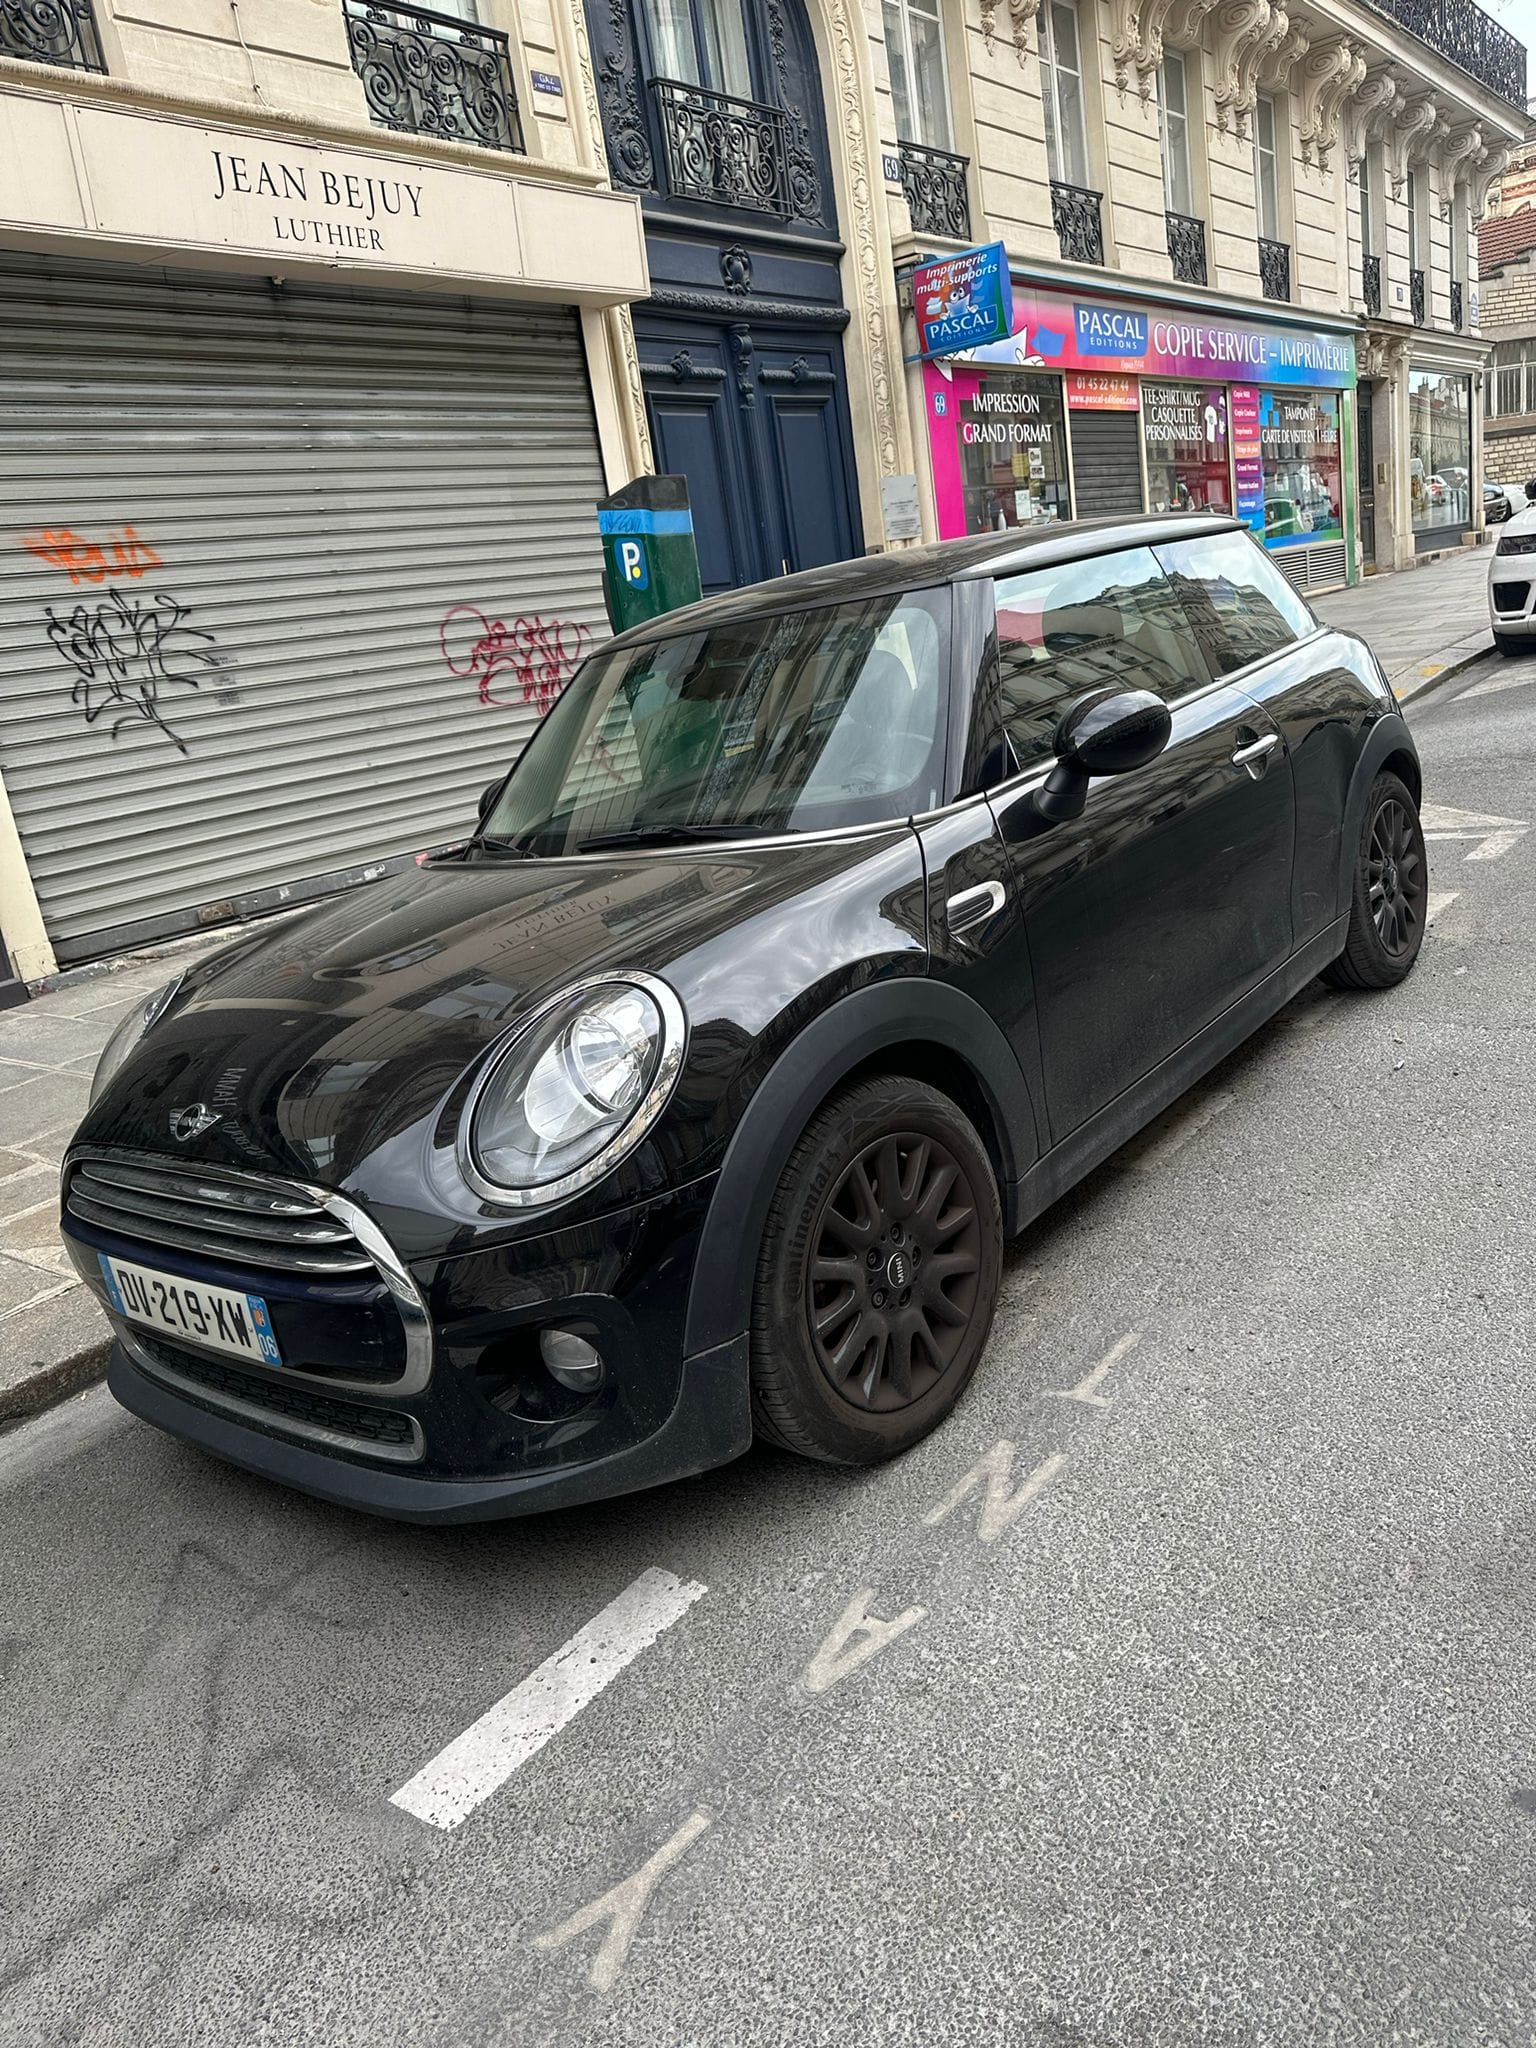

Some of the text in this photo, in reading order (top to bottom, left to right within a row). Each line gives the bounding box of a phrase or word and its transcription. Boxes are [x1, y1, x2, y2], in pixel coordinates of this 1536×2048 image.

[884, 157, 899, 180] 69
[210, 150, 423, 221] JEAN BEJUY
[272, 215, 385, 251] LUTHIER
[926, 253, 987, 279] Imprimerie
[917, 263, 998, 295] multi-supports
[929, 310, 994, 340] PASCAL
[1078, 310, 1144, 340] PASCAL
[1090, 336, 1137, 350] EDITIONS
[1153, 322, 1205, 358] COPIE
[1208, 329, 1267, 364] SERVICE
[1280, 339, 1350, 372] IMPRIMERIE
[1076, 377, 1129, 392] 01 45 22 47 44
[934, 395, 946, 414] 69
[972, 392, 1040, 414] IMPRESSION
[1069, 394, 1137, 406] www.pascal-editions.com
[1284, 406, 1316, 420] TAMPON ET
[963, 423, 1052, 443] GRAND FORMAT
[1262, 429, 1281, 443] CARTE
[1281, 429, 1290, 443] DE
[1290, 429, 1307, 443] VISITE
[1315, 425, 1320, 443] 1
[1320, 430, 1338, 443] HEURE
[621, 541, 641, 582] P
[894, 1256, 906, 1284] MINI
[116, 1268, 253, 1349] DV-219-XW
[258, 1333, 279, 1358] 06
